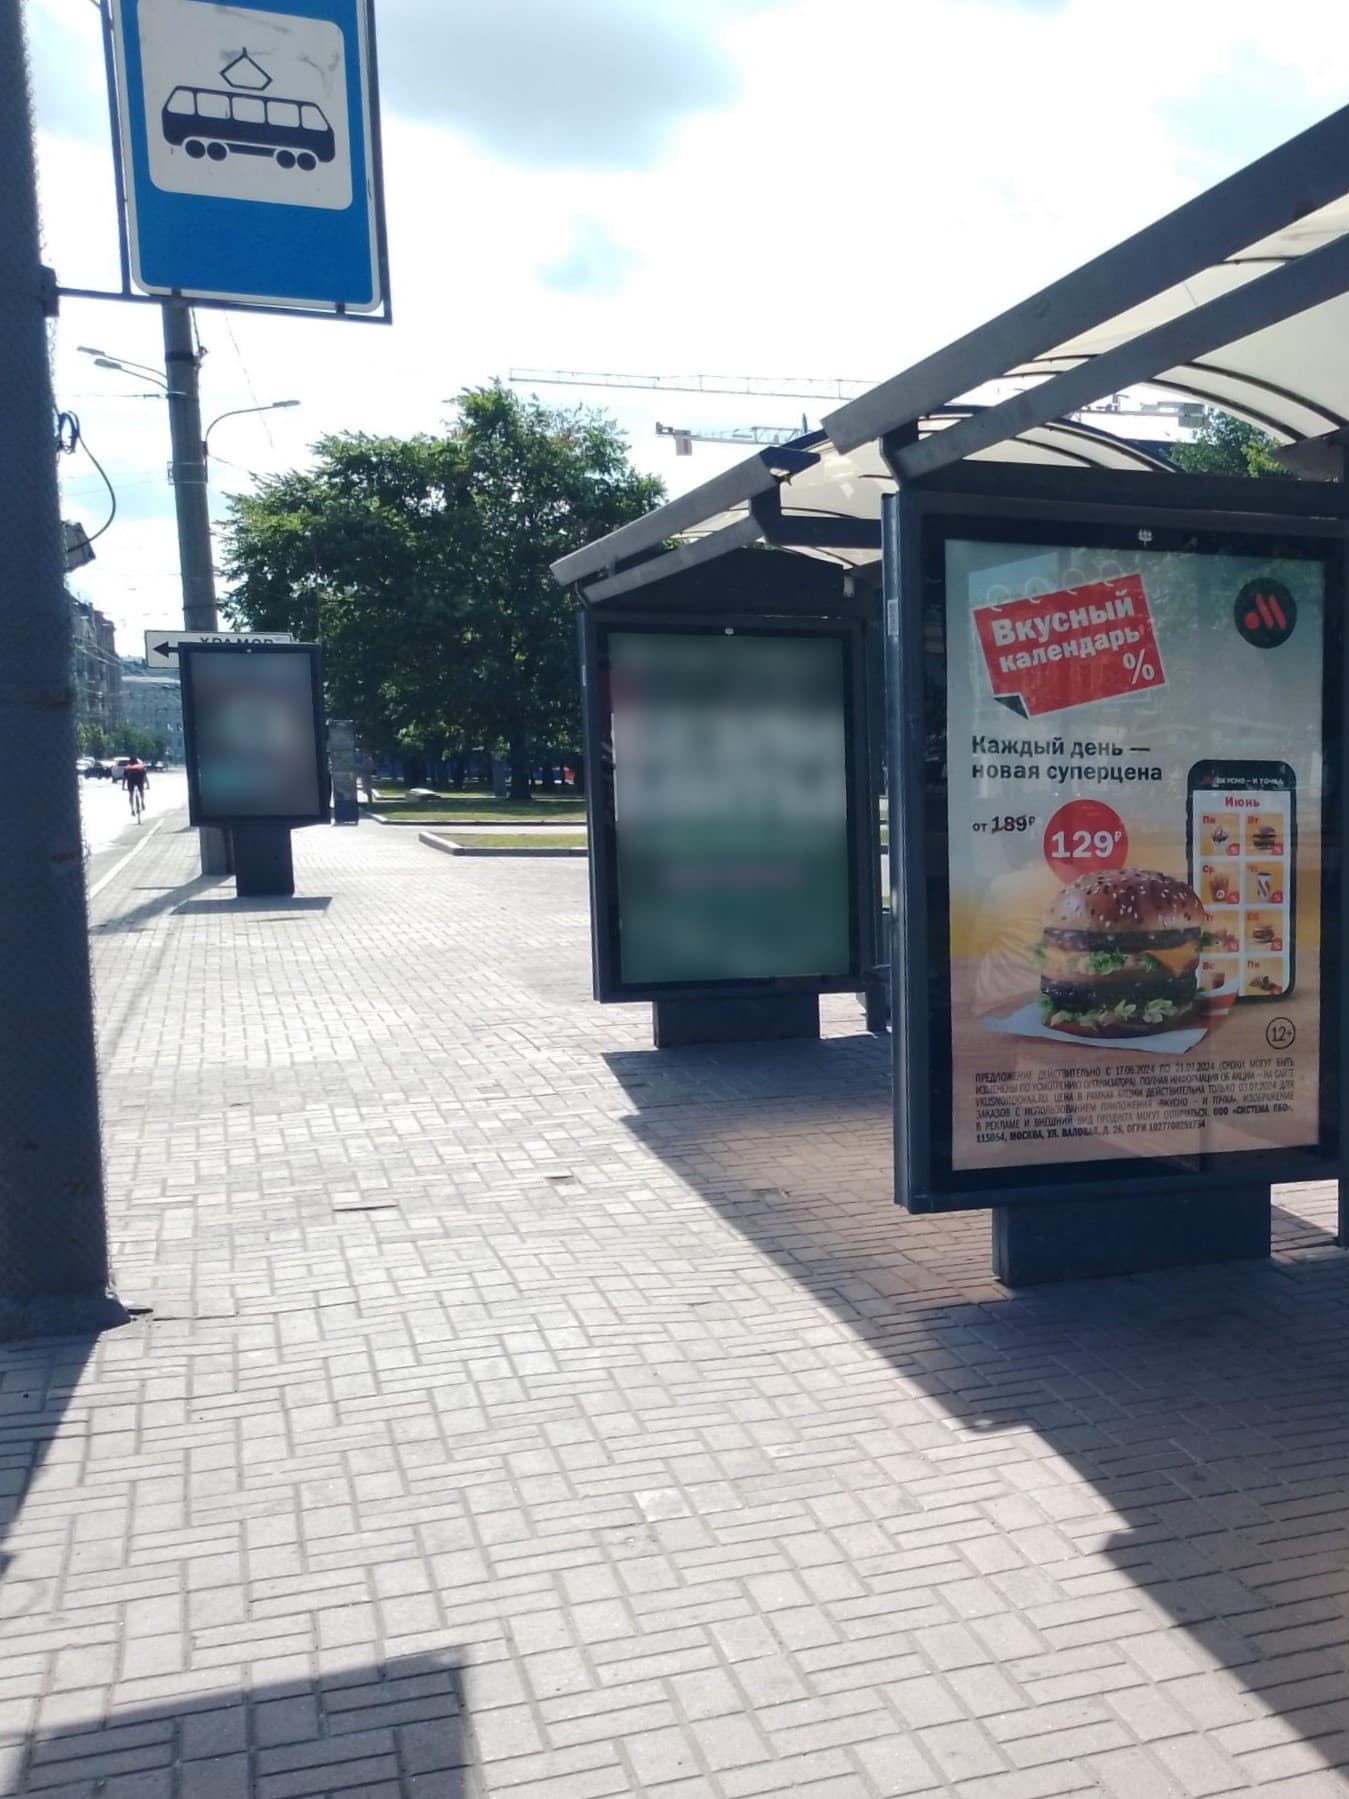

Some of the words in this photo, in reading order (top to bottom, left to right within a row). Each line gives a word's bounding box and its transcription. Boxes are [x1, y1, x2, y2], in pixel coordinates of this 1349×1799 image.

[991, 589, 1134, 647] Вкусный
[999, 627, 1140, 673] календарь
[1123, 649, 1155, 685] %
[970, 735, 1065, 758] Каждый
[1071, 740, 1124, 759] день
[971, 764, 1041, 780] новая
[1046, 764, 1163, 784] суперцена
[1225, 796, 1261, 808] Июнь
[971, 822, 987, 833] от
[1272, 1025, 1293, 1042] 12+
